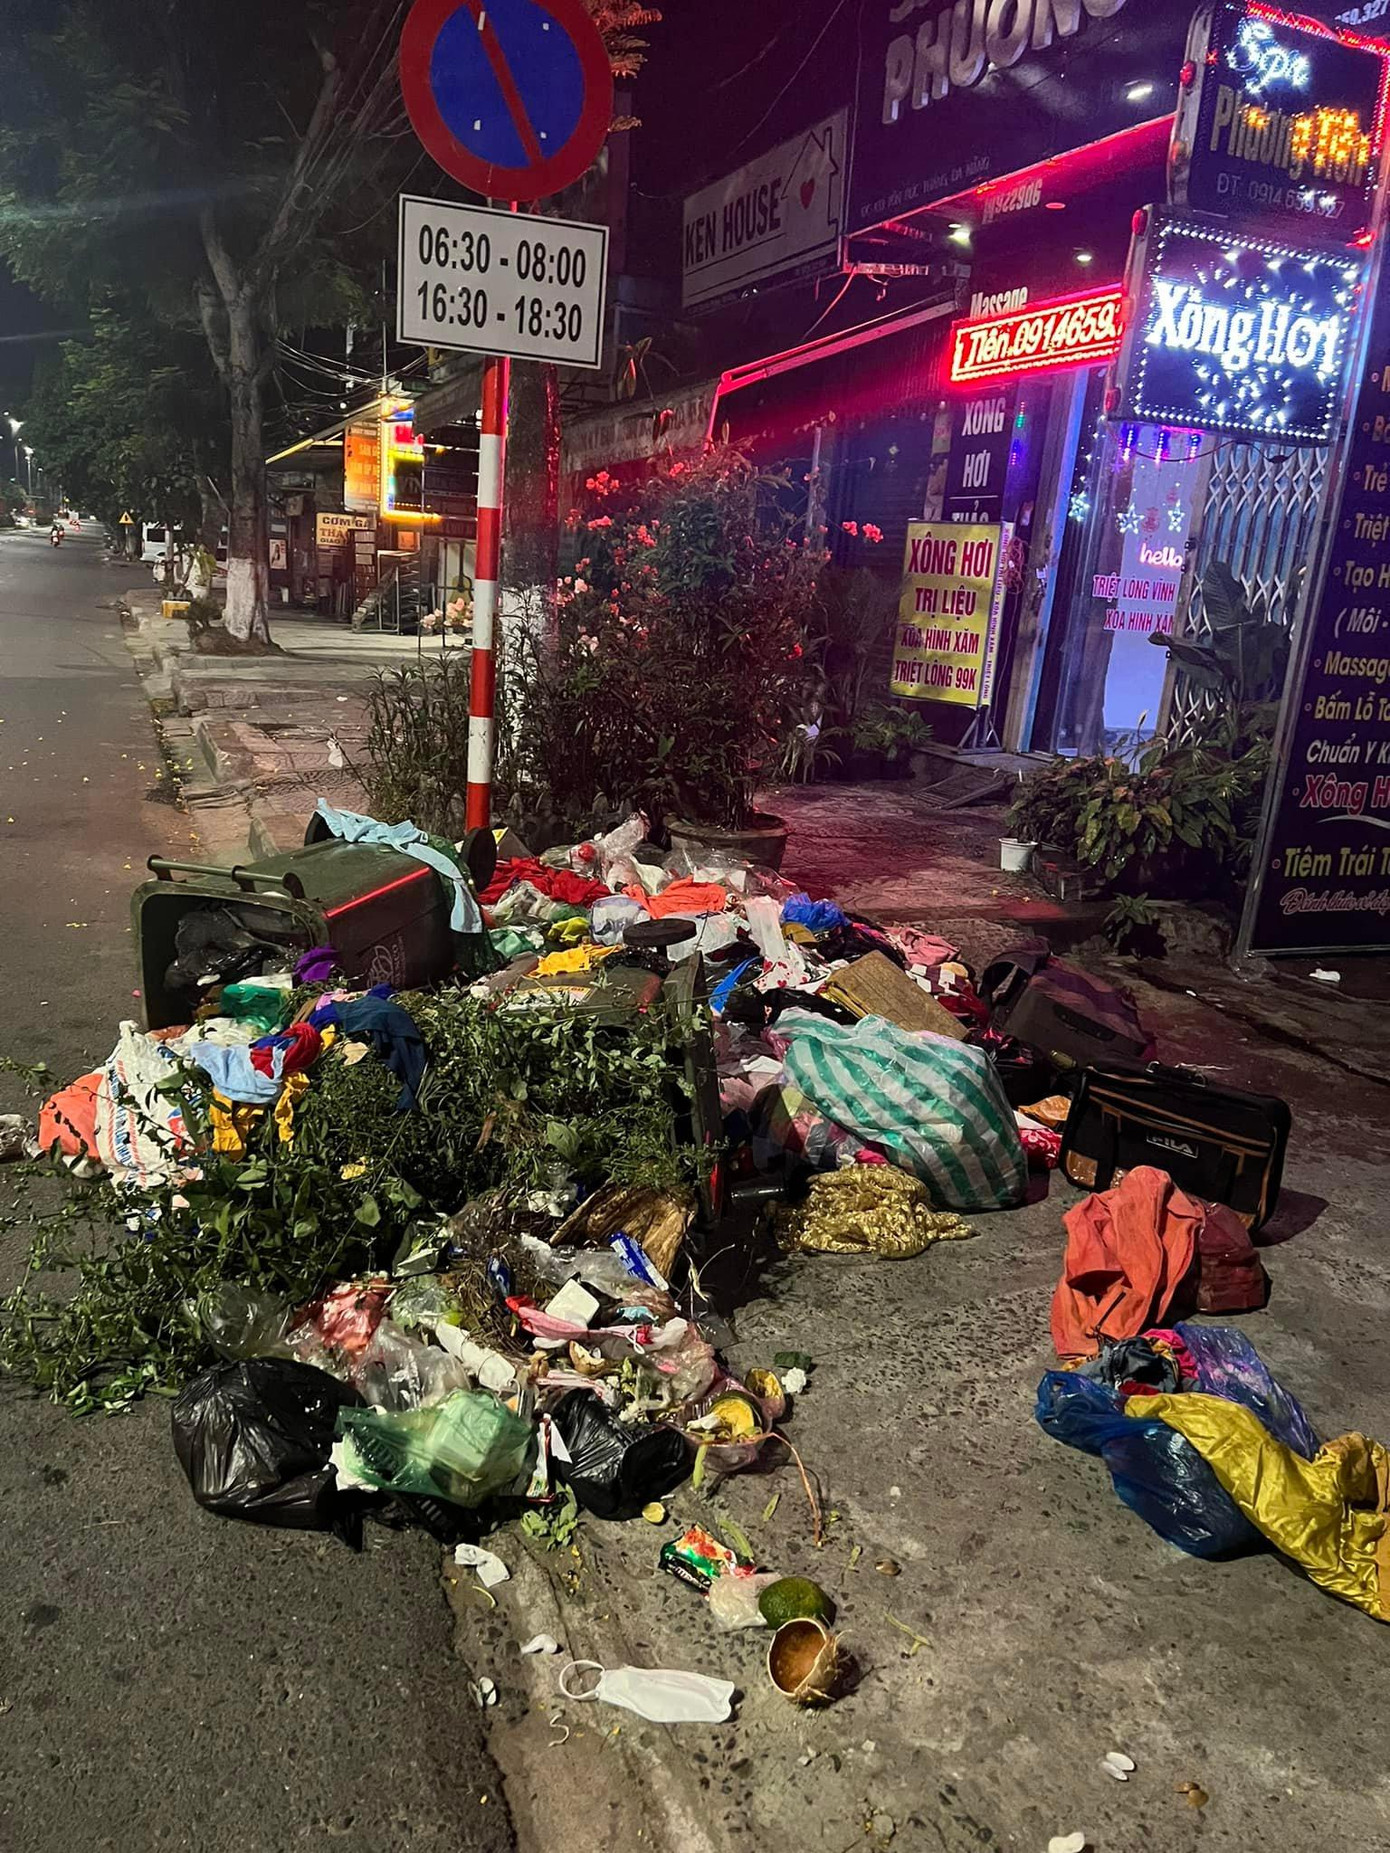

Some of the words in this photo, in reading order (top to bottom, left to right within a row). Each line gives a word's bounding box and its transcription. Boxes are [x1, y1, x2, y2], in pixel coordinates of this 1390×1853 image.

[685, 214, 716, 270] KEN
[722, 176, 783, 253] HOUSE
[419, 224, 491, 274] 06:30
[516, 240, 586, 288] 08:00
[417, 280, 488, 328] 16:30
[515, 295, 582, 342] 18:30
[962, 449, 991, 488] HƠI
[1364, 462, 1388, 492] Trẻ
[908, 531, 957, 575] XÔNG
[960, 538, 994, 578] HƠI
[1140, 542, 1184, 568] hello
[1344, 560, 1374, 594] Tạo
[915, 587, 938, 618] TRỊ
[941, 584, 977, 621] LIỆU
[924, 625, 951, 651] HÌNH
[952, 627, 980, 654] XĂM
[895, 657, 923, 688] TRIỆT
[924, 659, 953, 687] LÔNG
[955, 666, 977, 691] 99K
[1324, 651, 1390, 684] Massag
[1315, 690, 1352, 720] Bấm
[1306, 732, 1361, 764] Chuẩn
[1364, 741, 1378, 764] Y
[1299, 772, 1369, 817] Xông
[1284, 844, 1332, 877] Tiêm
[1339, 843, 1377, 876] Trái
